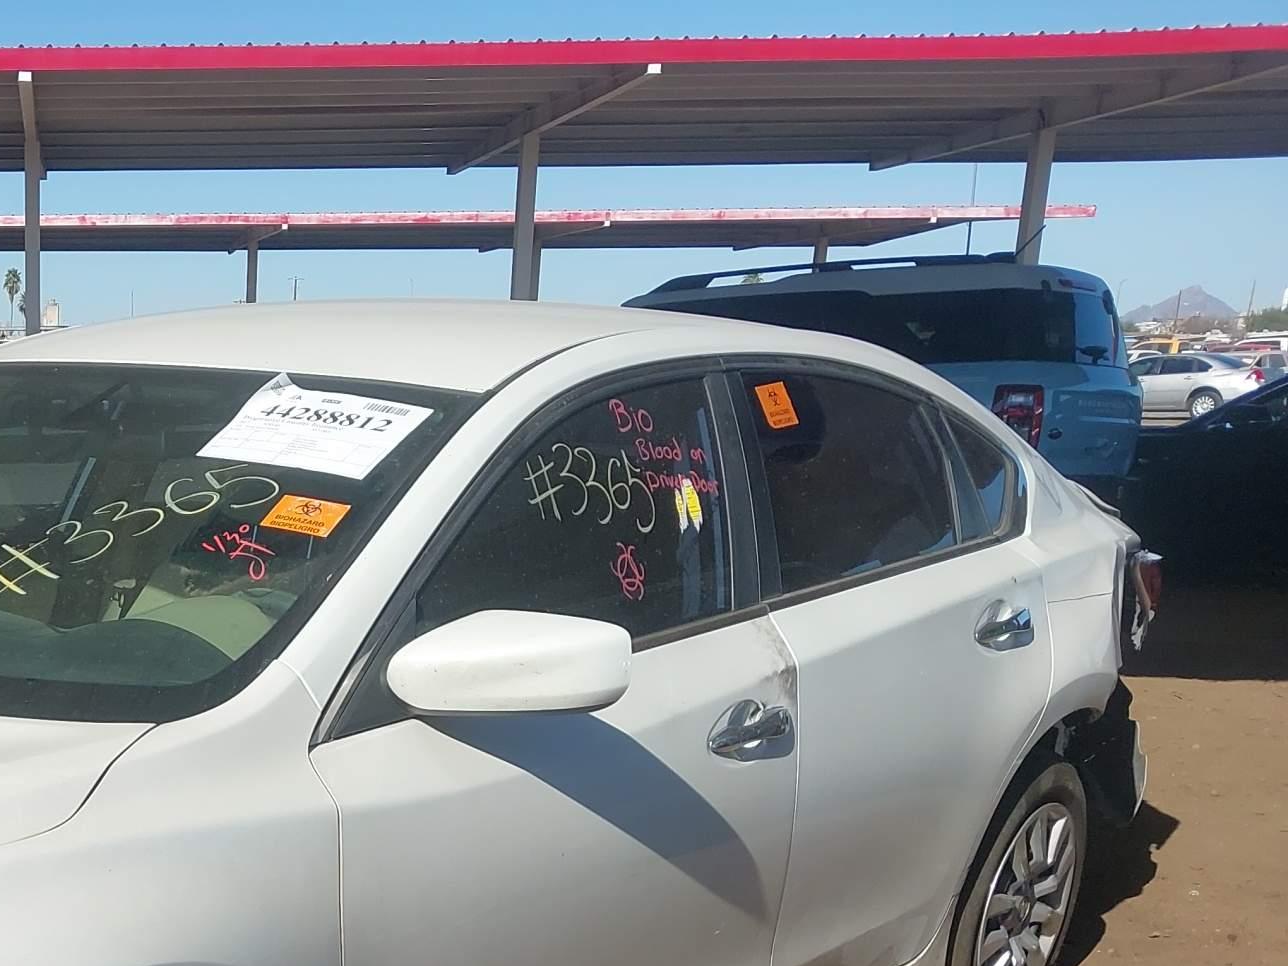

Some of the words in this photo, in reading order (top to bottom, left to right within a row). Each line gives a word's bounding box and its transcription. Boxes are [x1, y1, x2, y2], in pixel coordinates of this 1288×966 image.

[259, 403, 393, 432] 44288812
[635, 437, 682, 461] Blood
[690, 447, 707, 465] on
[524, 442, 656, 533] #3365
[270, 520, 321, 534] BIOPELIGRO
[274, 513, 325, 528] BIOHAZARD
